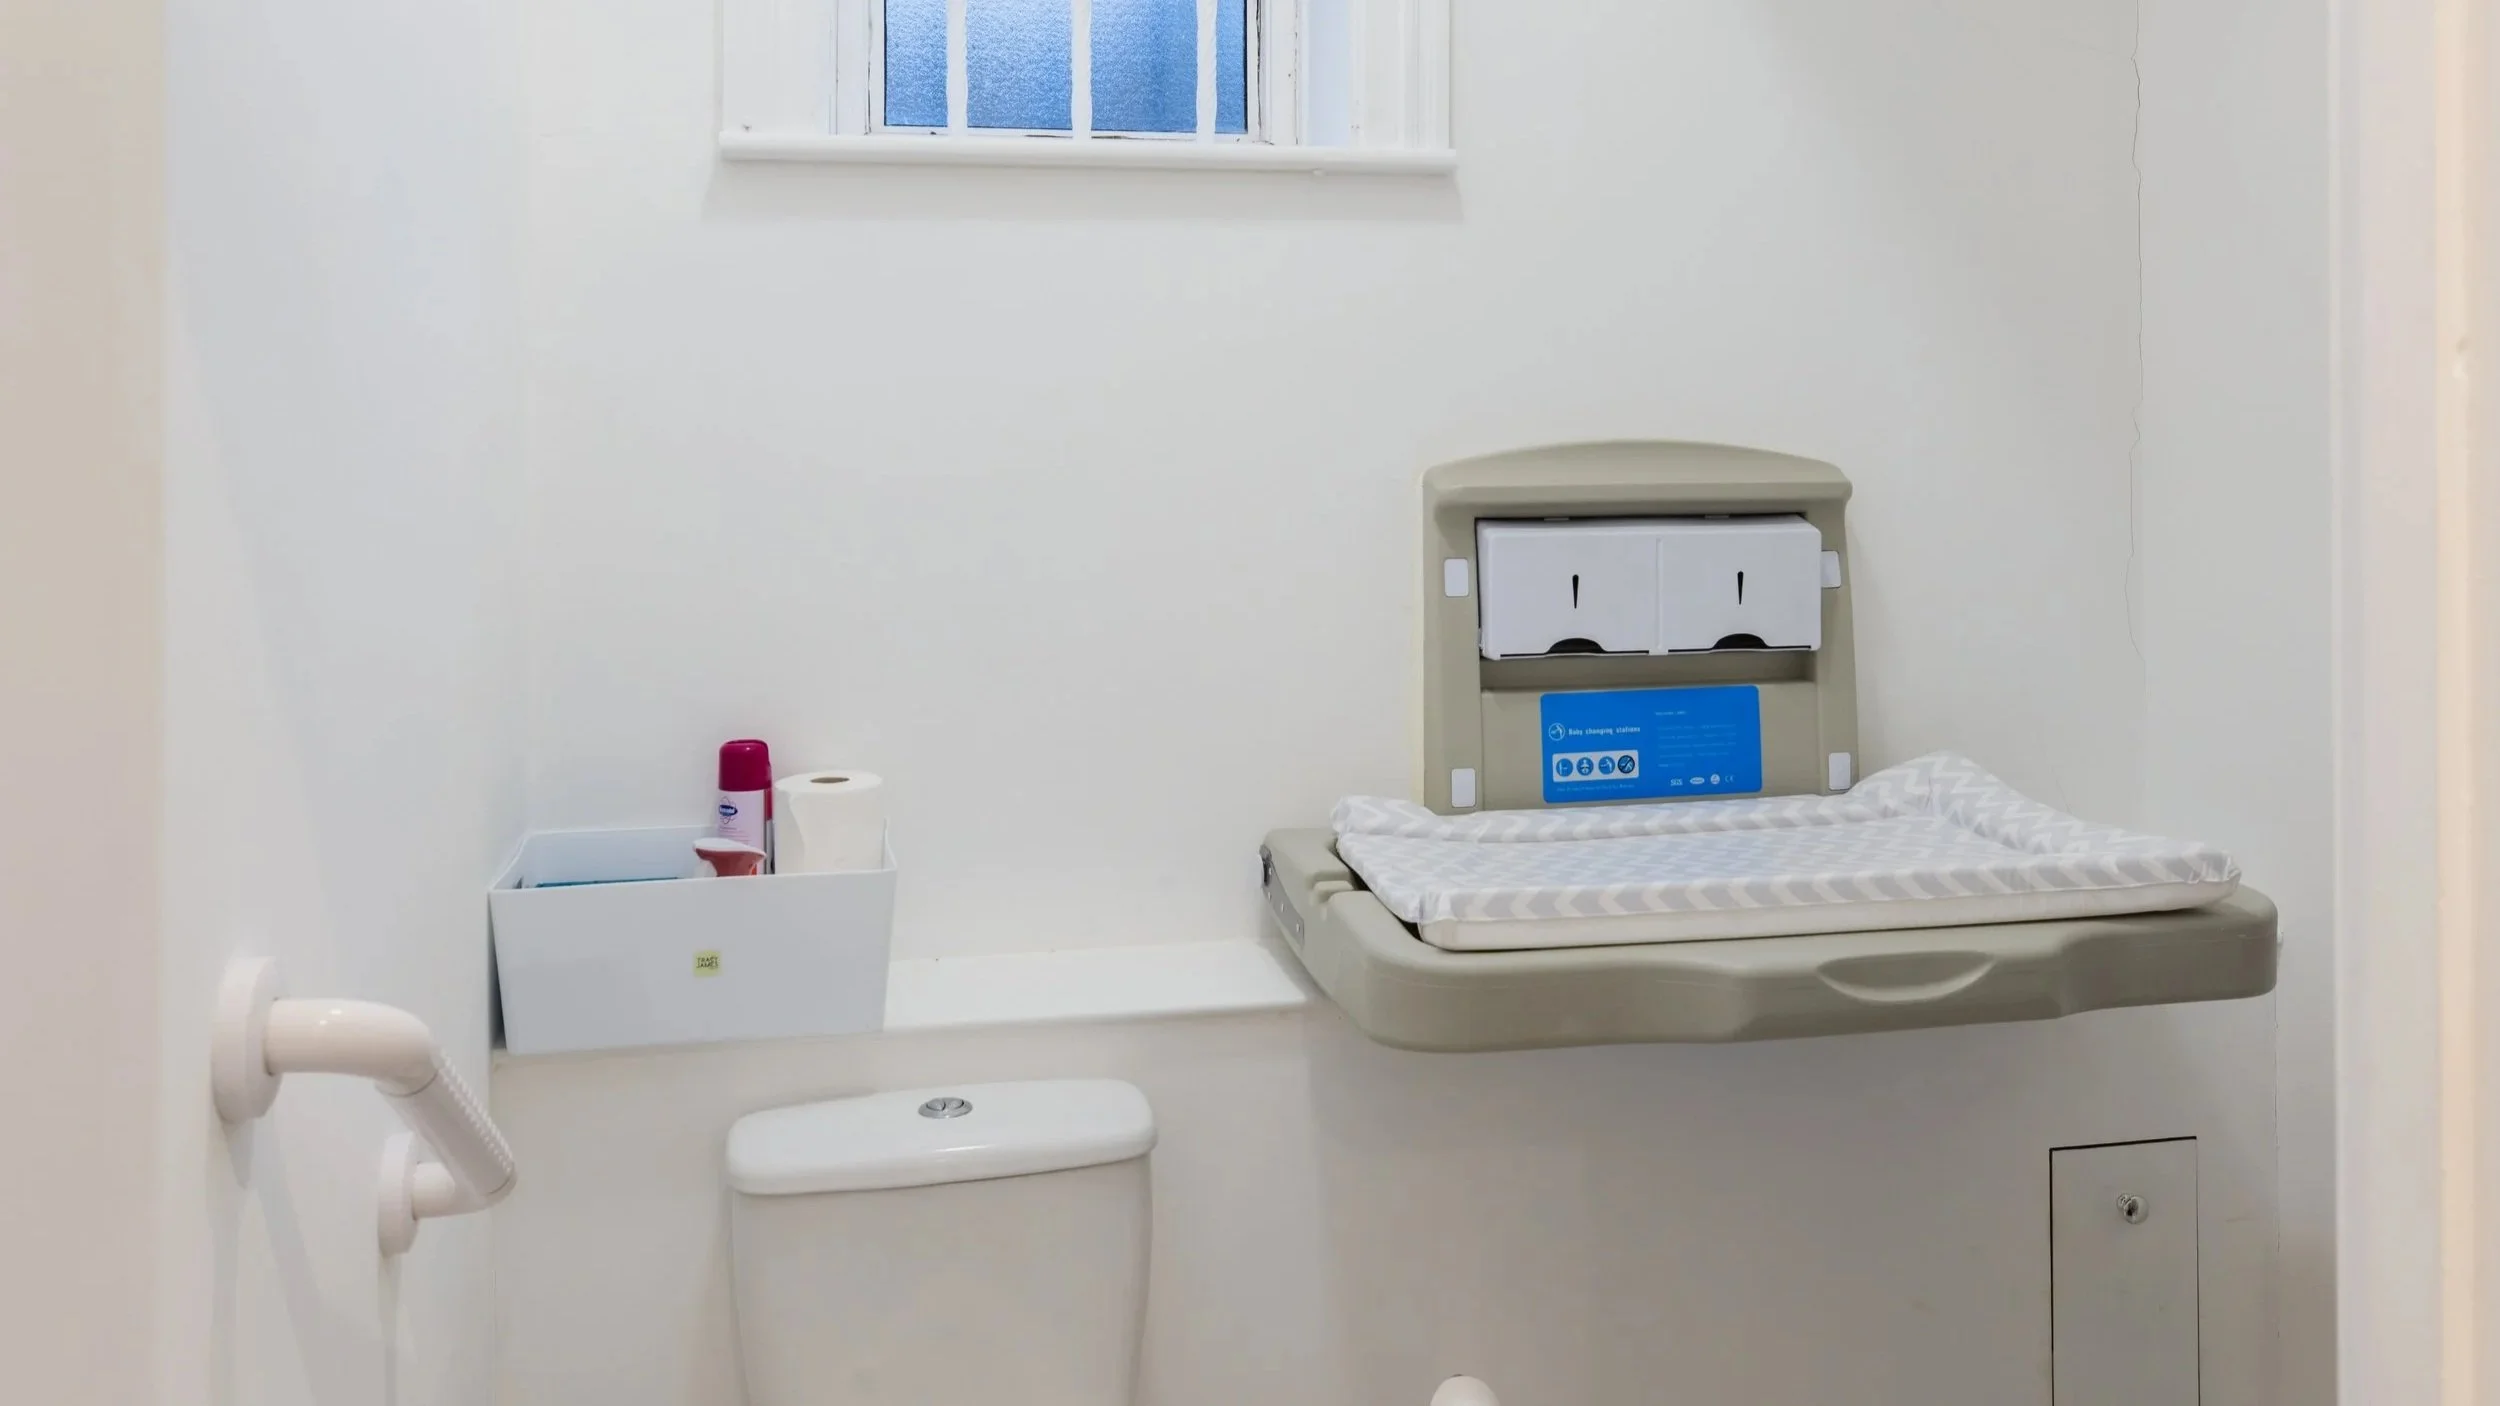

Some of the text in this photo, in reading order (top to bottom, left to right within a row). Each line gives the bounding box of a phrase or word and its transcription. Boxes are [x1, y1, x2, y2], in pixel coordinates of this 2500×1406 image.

[1568, 726, 1641, 736] Baby changing stations
